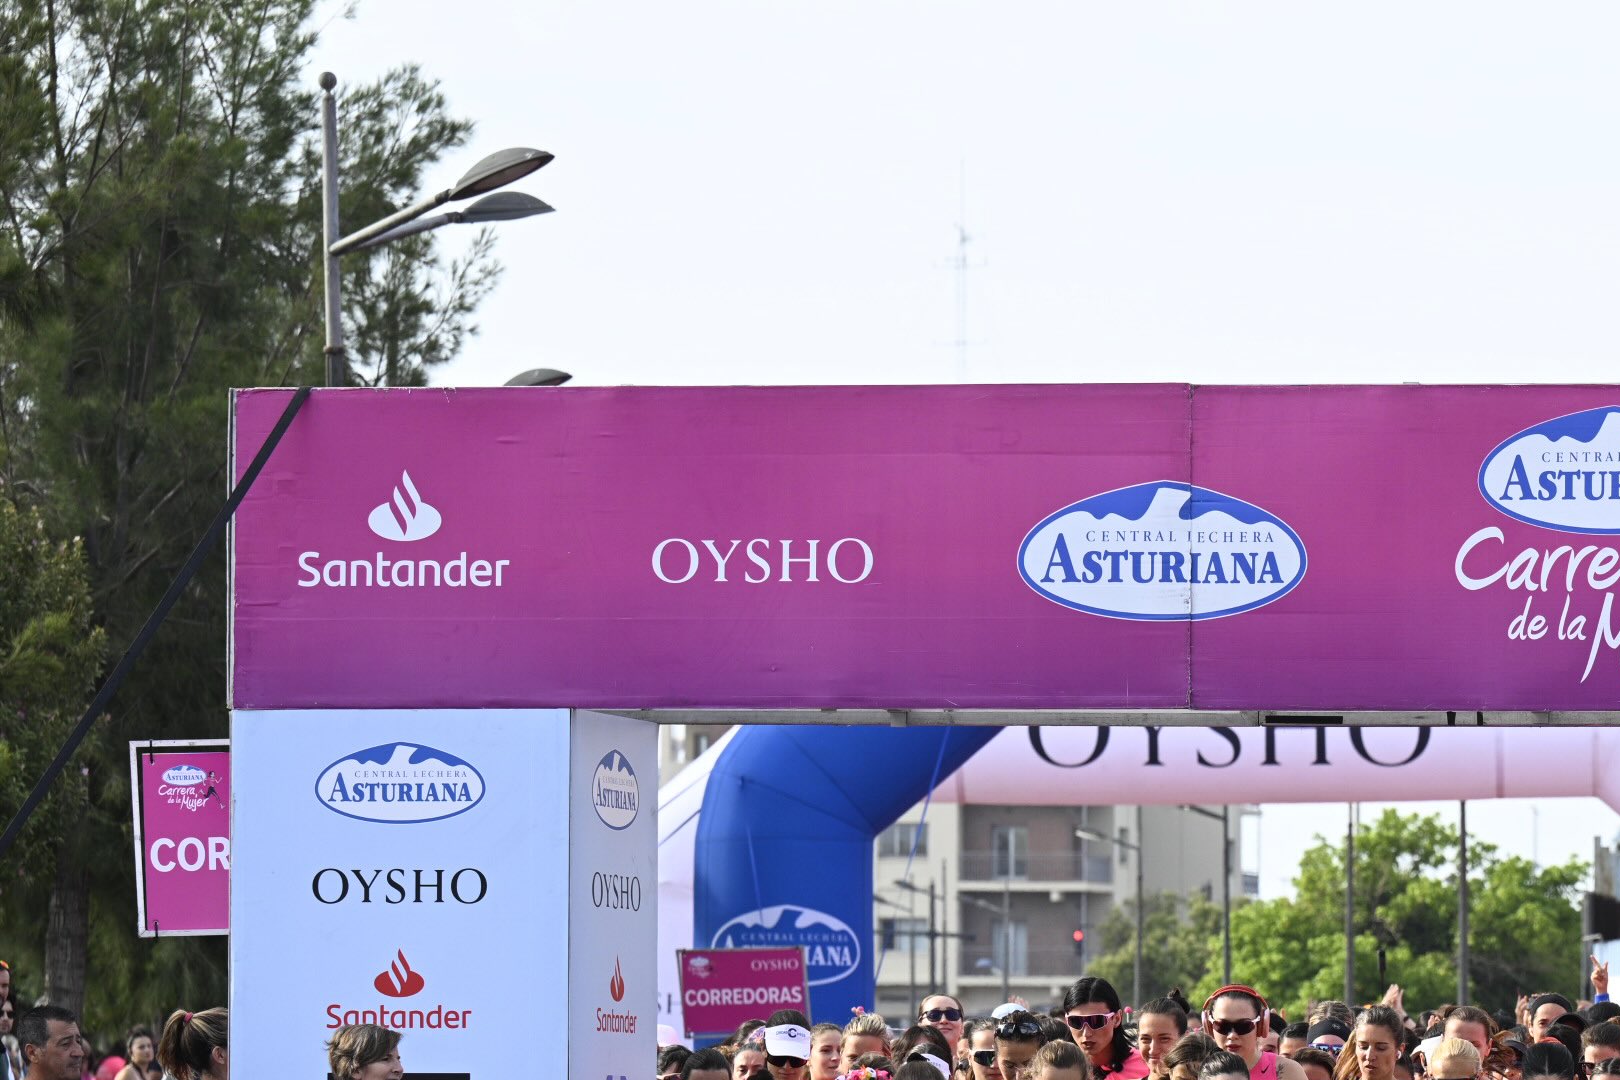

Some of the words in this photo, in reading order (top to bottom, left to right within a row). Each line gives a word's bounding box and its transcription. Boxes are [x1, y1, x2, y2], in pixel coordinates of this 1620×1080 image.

[1086, 530, 1177, 542] CENTRAL
[297, 551, 509, 587] Santander
[651, 538, 874, 584] OYSHO
[1040, 533, 1284, 584] ASTURIANA
[1507, 596, 1548, 641] de
[1558, 595, 1587, 641] la
[328, 772, 473, 803] ASTURIANA
[354, 770, 407, 778] CENTRAL
[413, 770, 468, 778] LECHERA
[158, 784, 196, 797] Carrera
[180, 792, 208, 812] Mujer
[596, 777, 636, 811] ASTURIANA
[312, 868, 487, 905] OYSHO
[592, 872, 641, 912] OYSHO
[751, 958, 799, 972] OYSHO
[685, 986, 802, 1007] CORREDORAS
[326, 1004, 472, 1029] Santander
[596, 1007, 637, 1034] Santander
